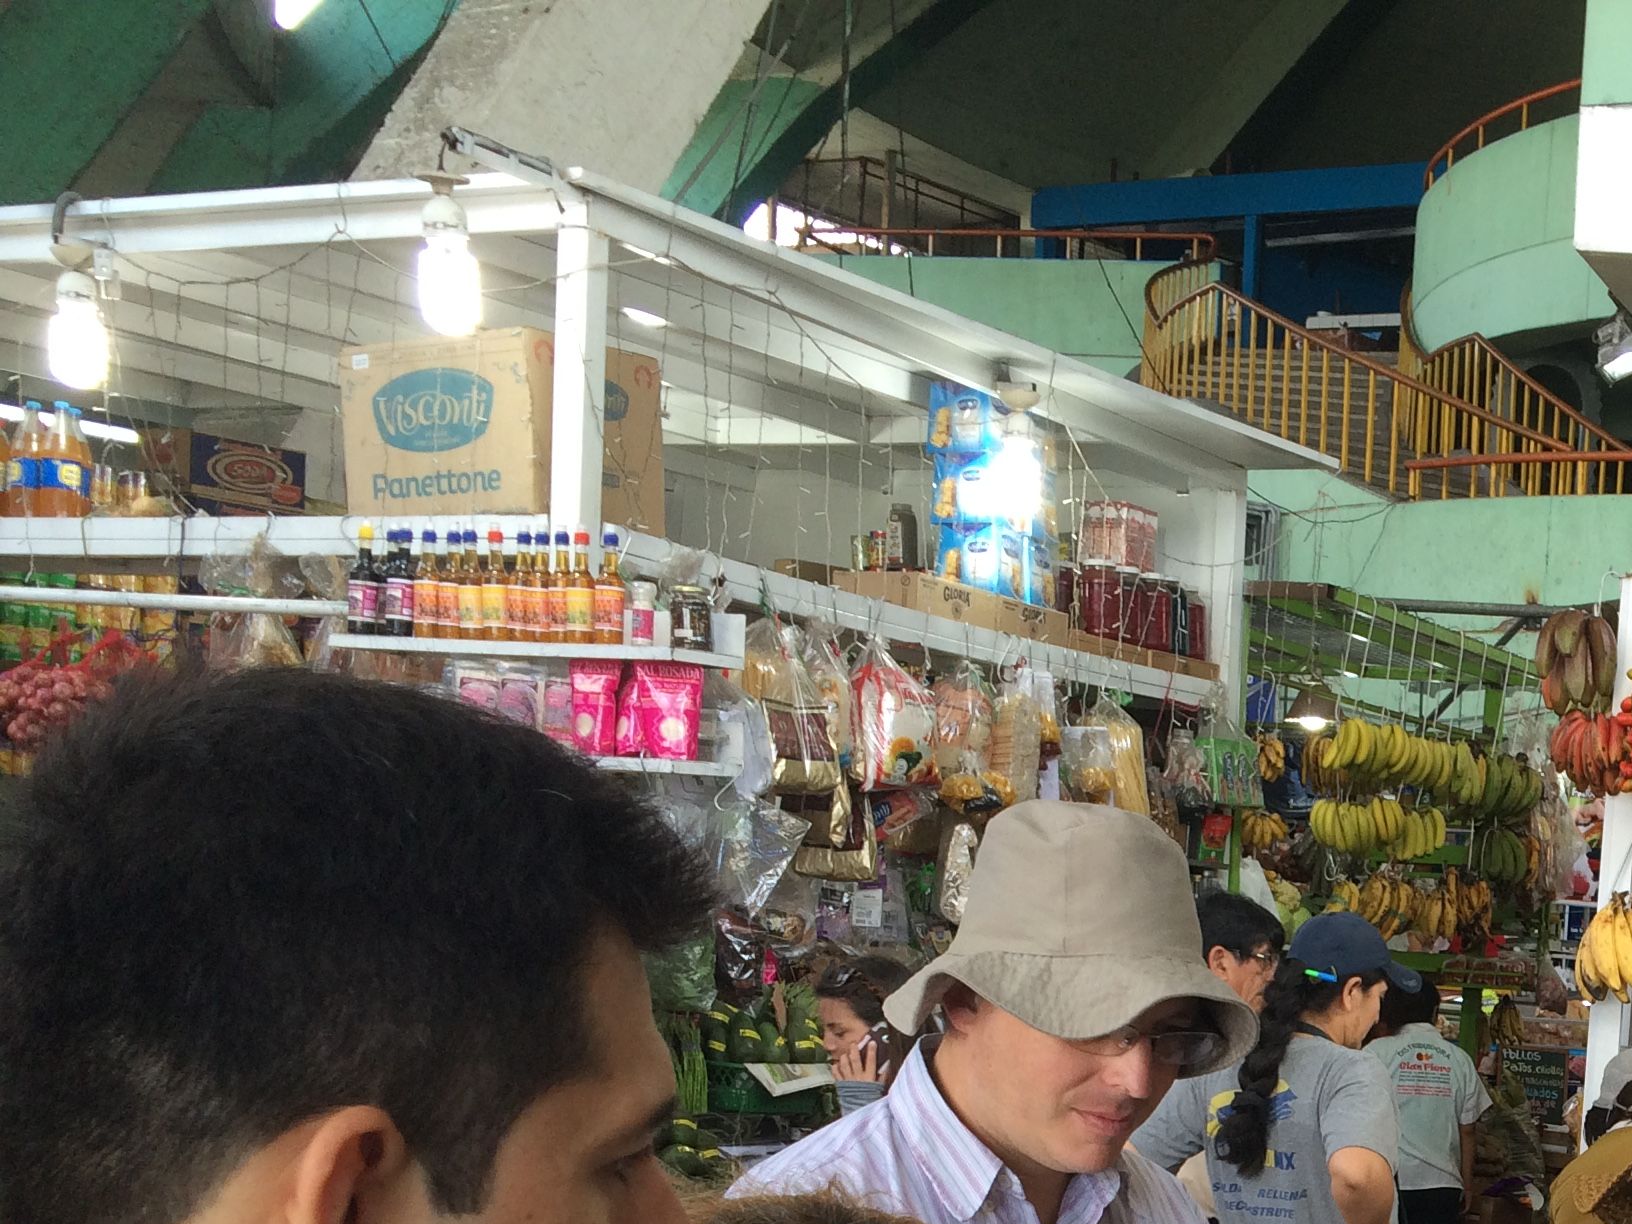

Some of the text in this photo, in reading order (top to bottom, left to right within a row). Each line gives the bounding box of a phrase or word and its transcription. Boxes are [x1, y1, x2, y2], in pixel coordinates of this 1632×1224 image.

[378, 383, 487, 436] Visconti
[372, 469, 501, 500] Panettone
[943, 585, 971, 607] GLORIA
[660, 664, 702, 681] ROSADA
[1257, 1188, 1308, 1202] RELLENA
